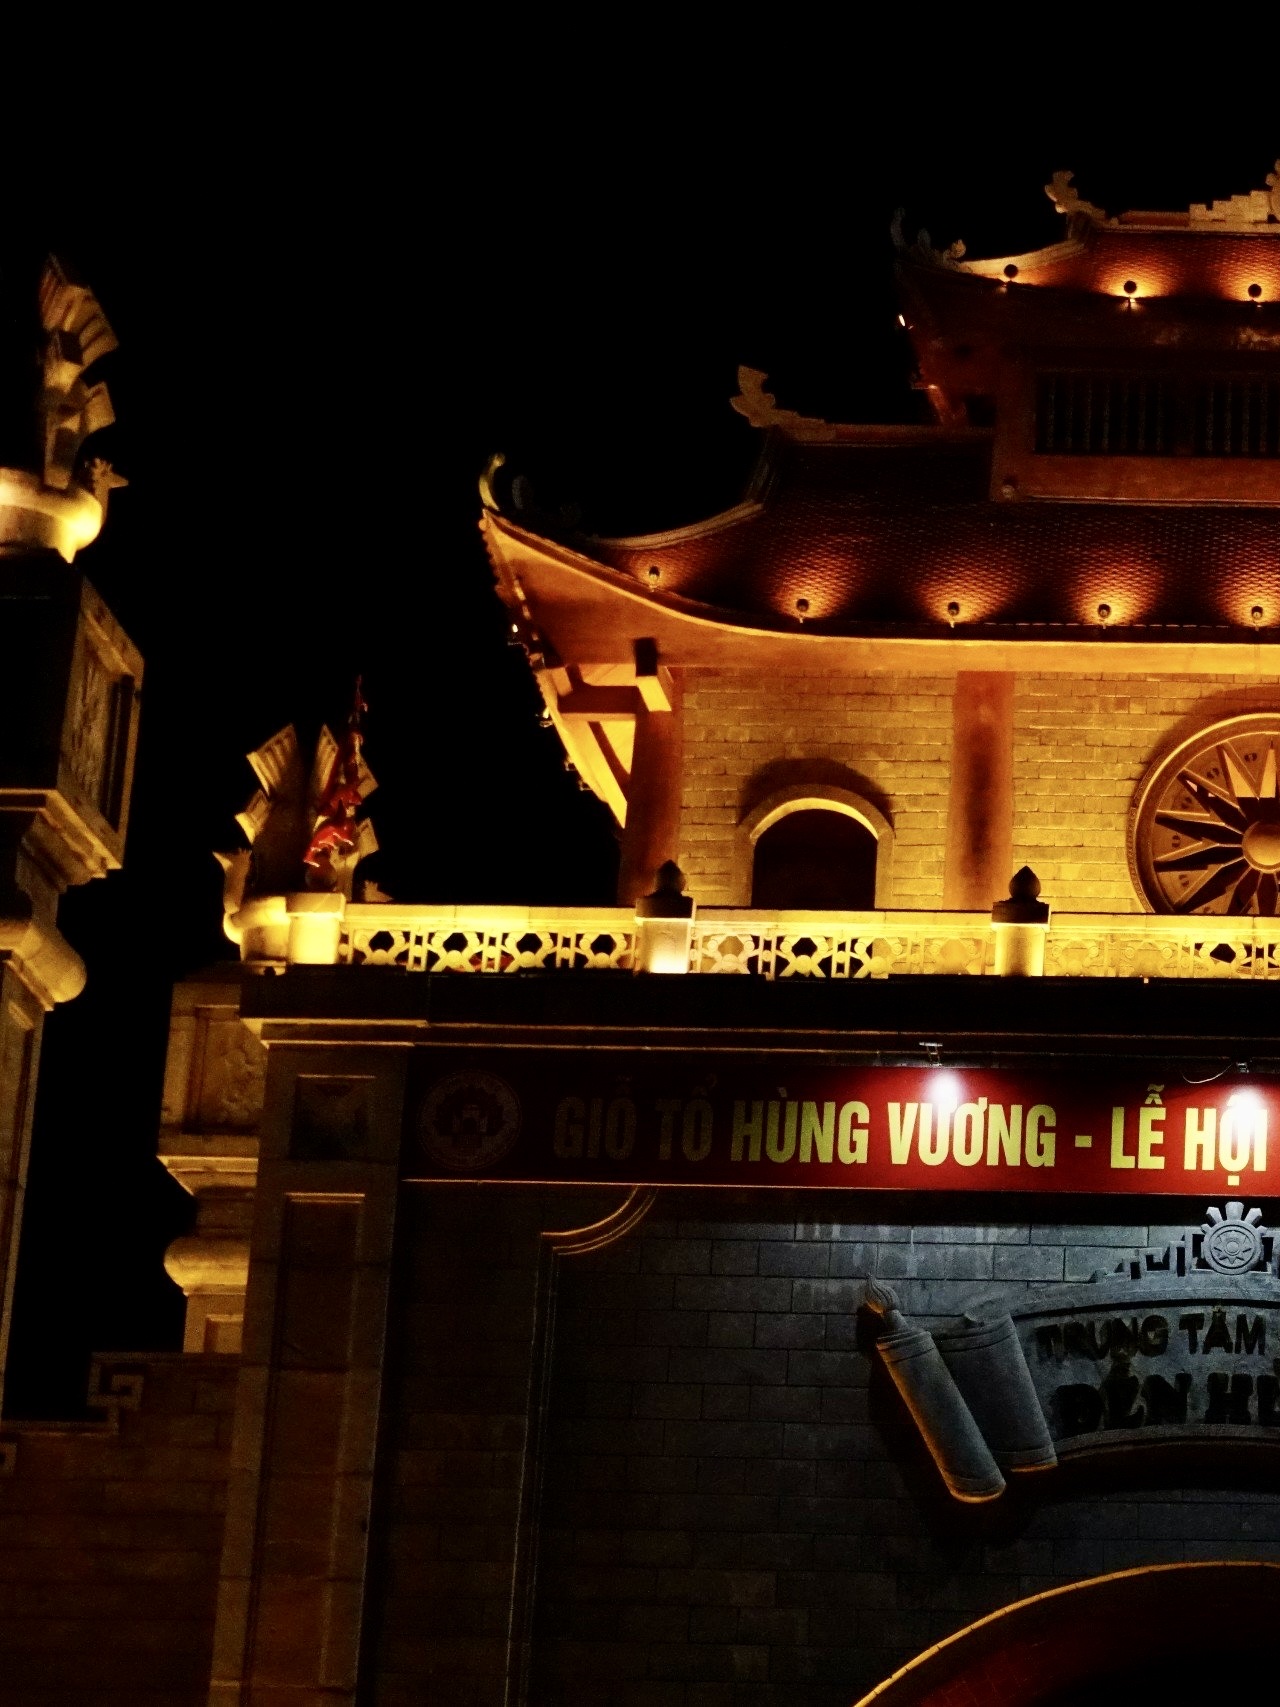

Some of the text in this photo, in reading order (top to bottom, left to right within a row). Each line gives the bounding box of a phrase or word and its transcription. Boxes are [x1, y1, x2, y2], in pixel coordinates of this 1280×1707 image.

[731, 1086, 870, 1164] HÙNG
[888, 1097, 1057, 1168] VƯƠNG
[1075, 1135, 1093, 1148] -
[1110, 1084, 1167, 1170] LỄ
[1184, 1094, 1268, 1186] HỘI
[1036, 1315, 1169, 1363] TRUNG
[1179, 1304, 1266, 1355] TÂM
